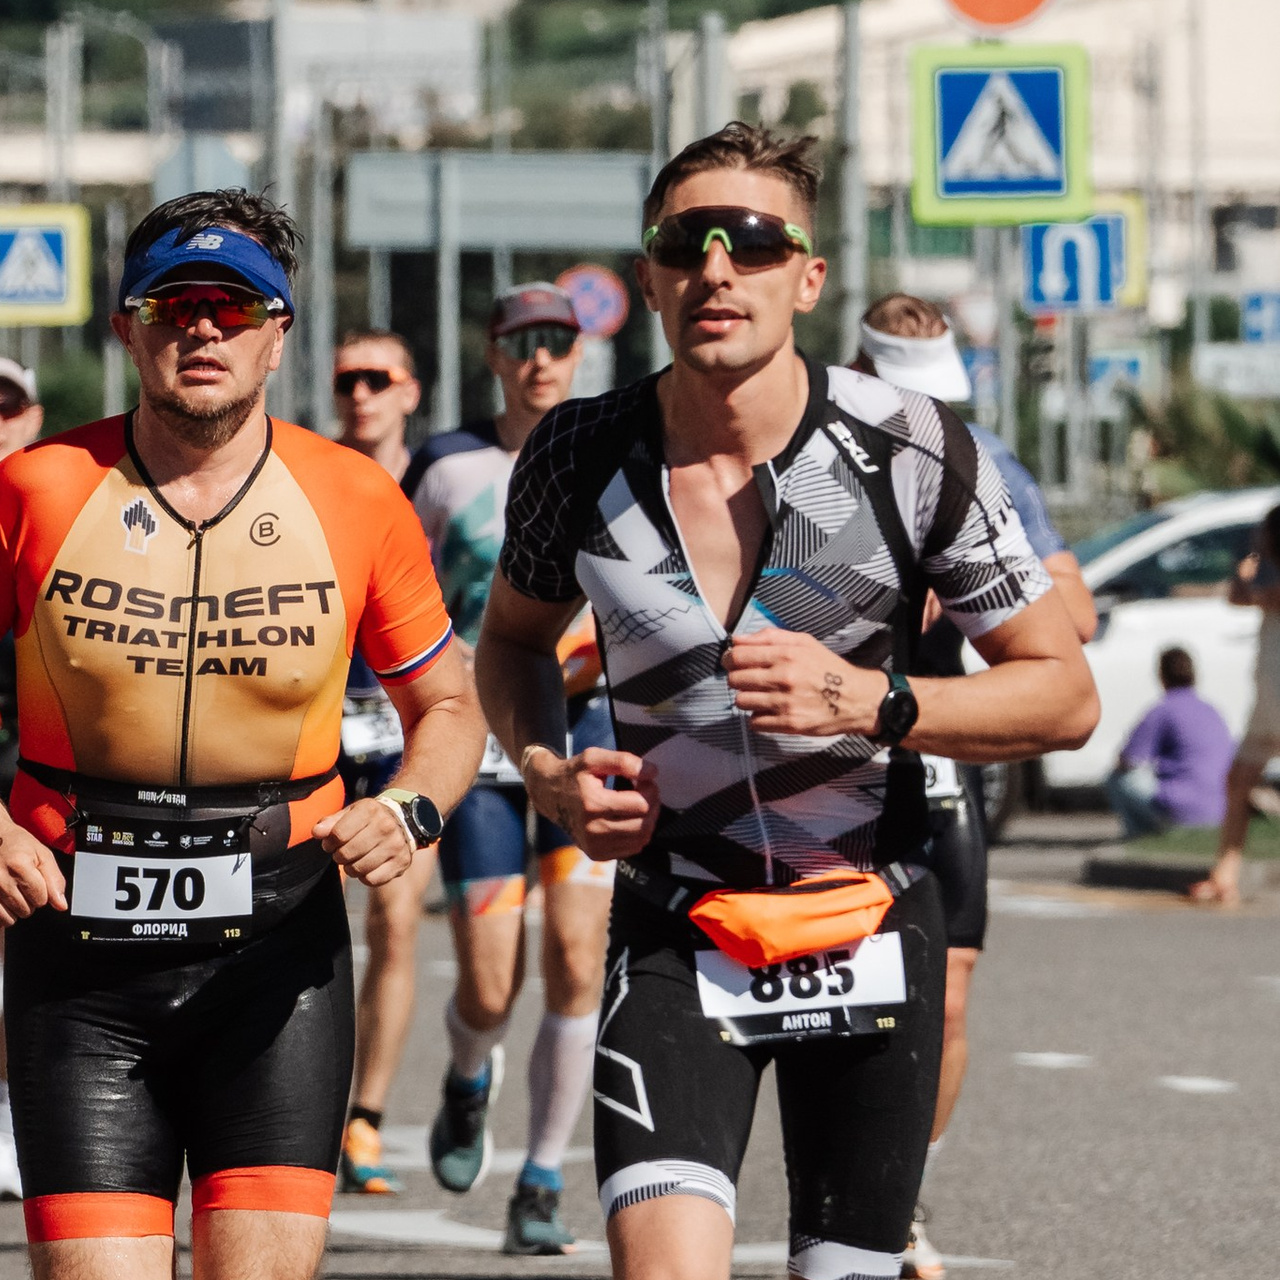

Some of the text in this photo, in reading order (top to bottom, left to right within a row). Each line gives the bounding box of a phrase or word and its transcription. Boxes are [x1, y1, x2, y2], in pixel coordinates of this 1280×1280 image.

[63, 615, 316, 648] TRIATHLON
[126, 655, 268, 676] TEAM
[115, 866, 206, 912] 570
[132, 923, 188, 937] ФЛОРИД
[224, 928, 241, 938] 113
[748, 949, 855, 1003] 885
[782, 1012, 831, 1030] АНТОН
[876, 1017, 895, 1028] 113
